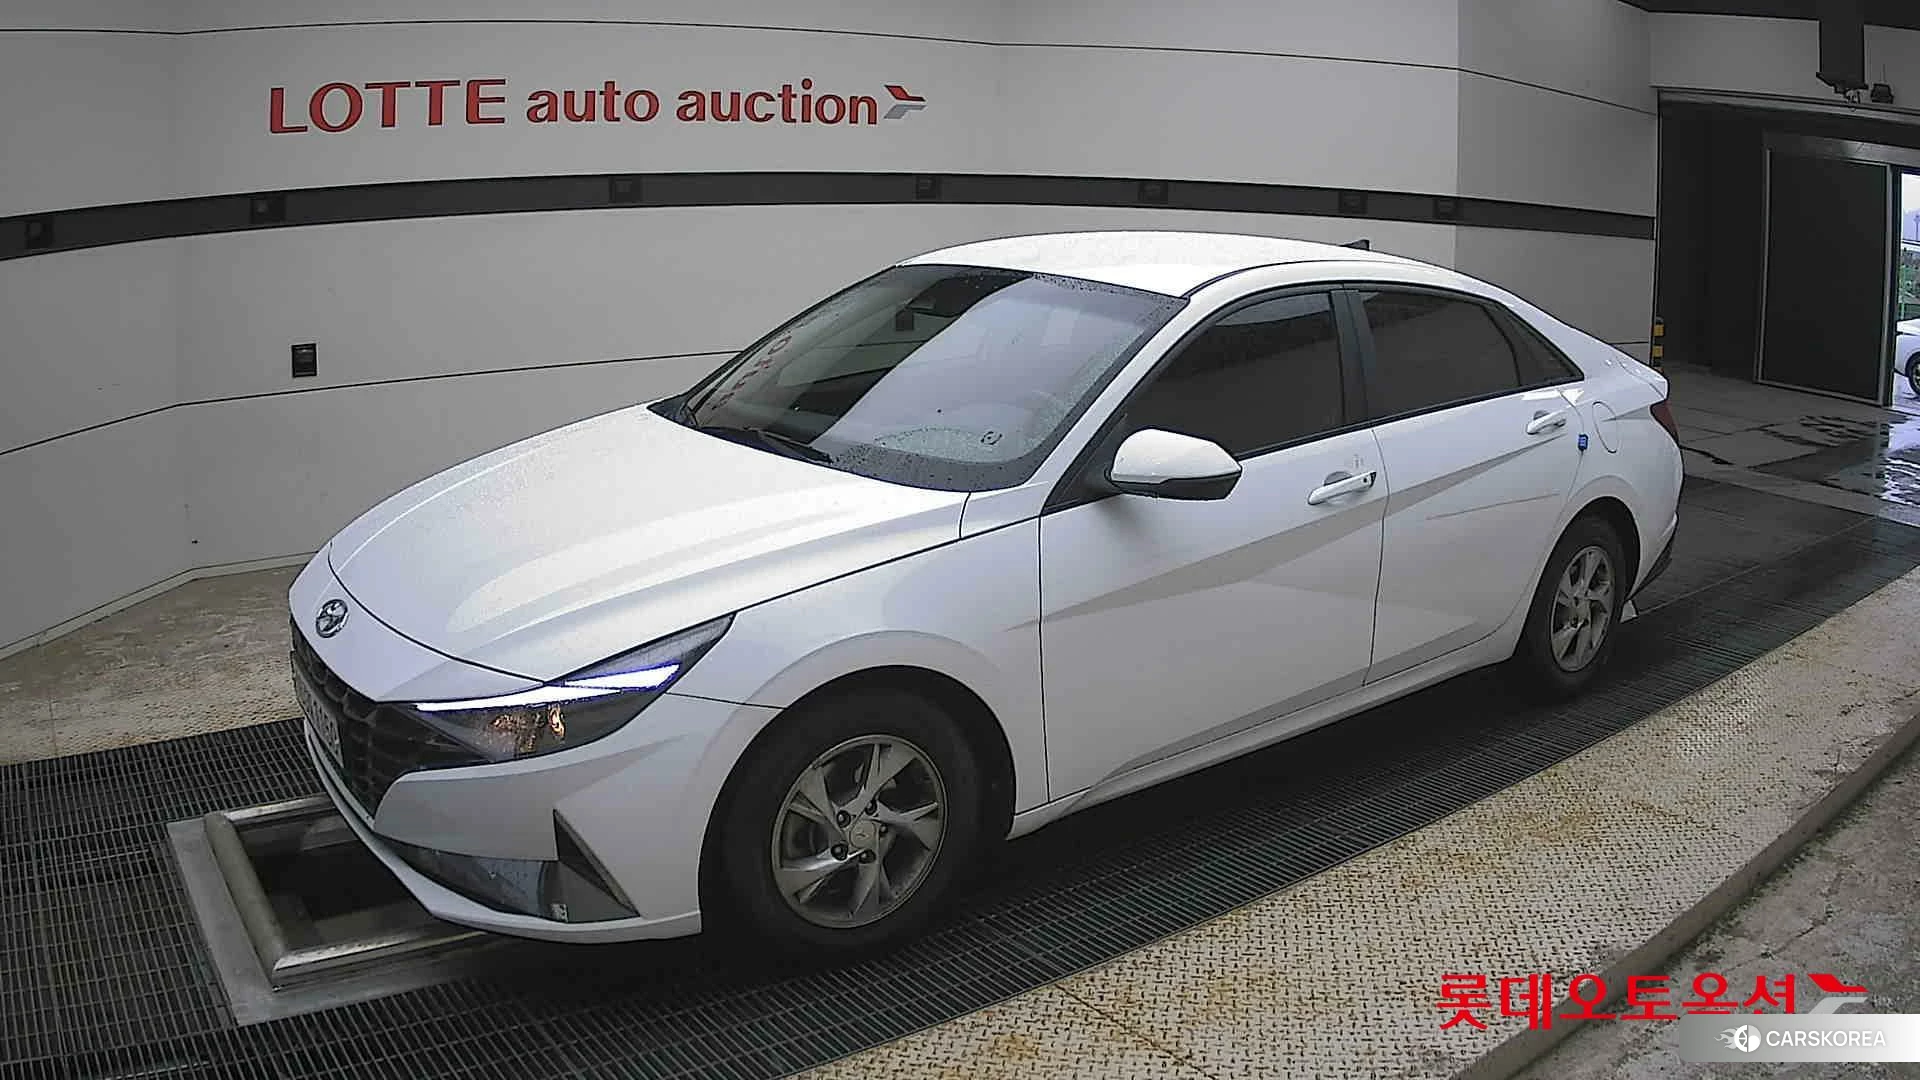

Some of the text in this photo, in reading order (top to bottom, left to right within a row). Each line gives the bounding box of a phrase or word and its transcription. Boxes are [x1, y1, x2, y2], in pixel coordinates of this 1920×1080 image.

[269, 78, 879, 134] LOTTE auto auction
